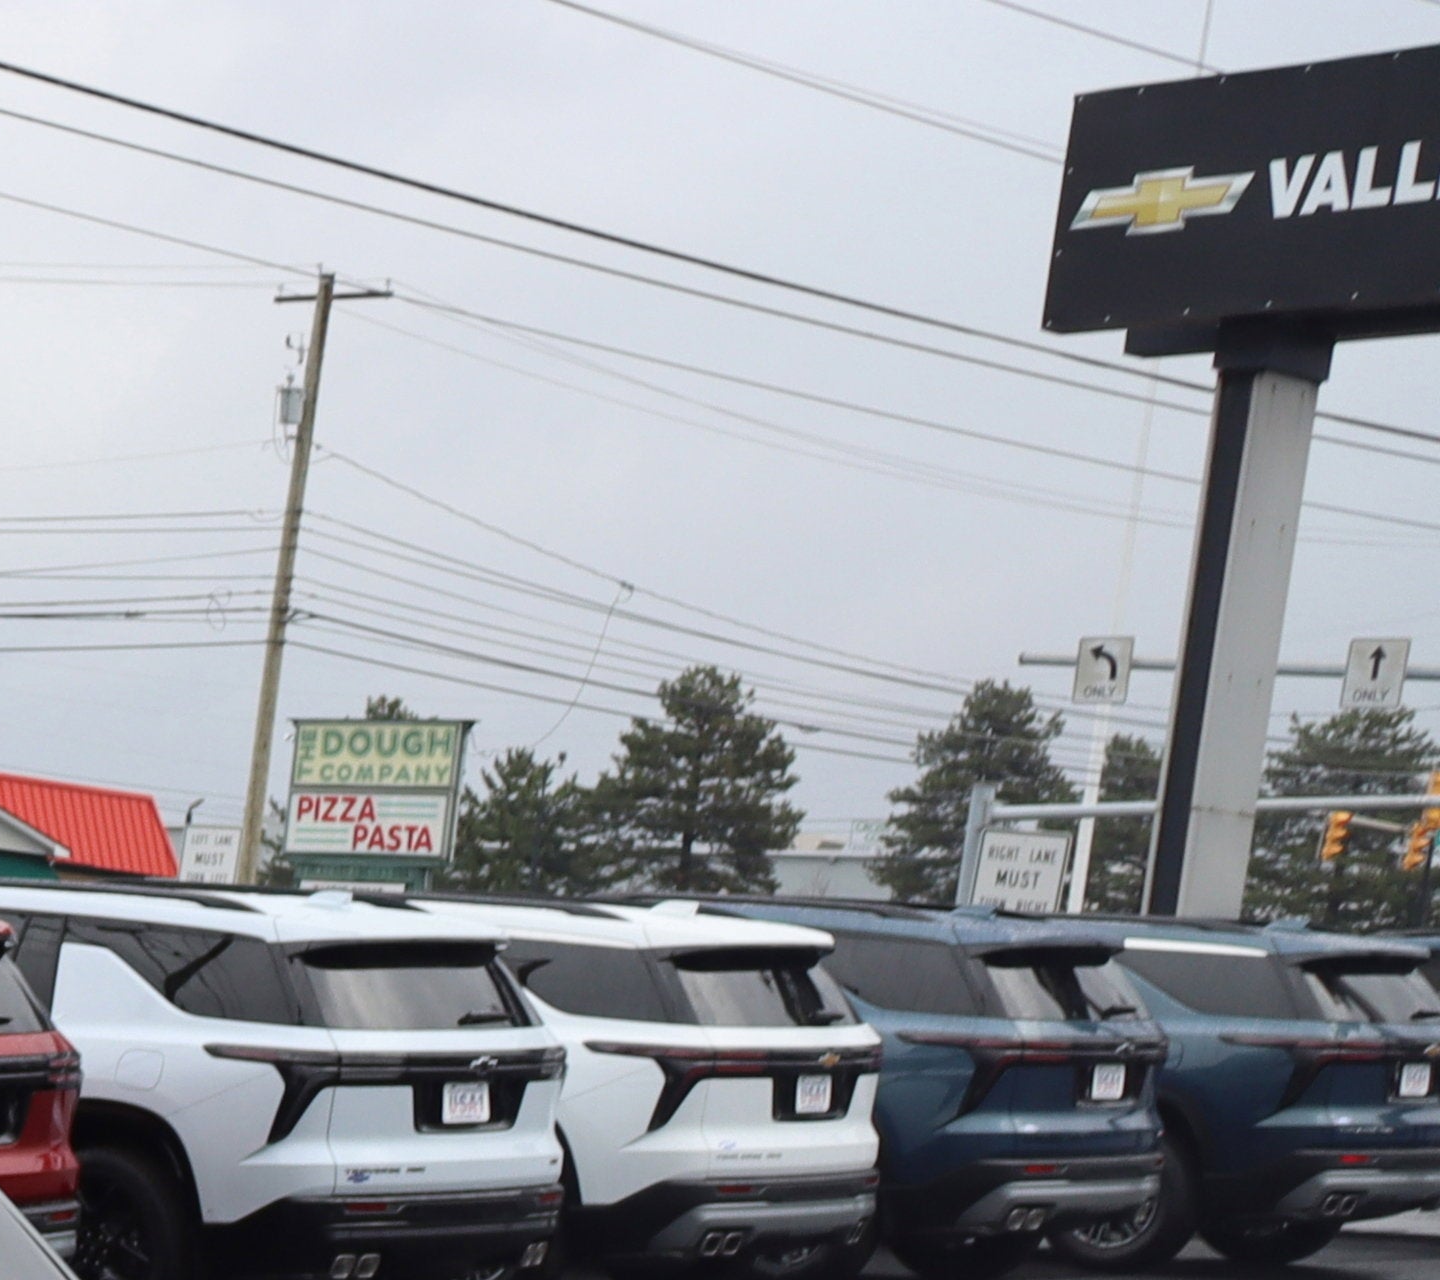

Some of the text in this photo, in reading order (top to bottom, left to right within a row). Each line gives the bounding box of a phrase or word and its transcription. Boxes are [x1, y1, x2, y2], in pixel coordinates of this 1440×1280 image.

[1269, 139, 1440, 219] VALL
[1083, 685, 1117, 699] ONLY
[1352, 687, 1393, 702] ONLY
[323, 728, 451, 759] DOUGH
[297, 729, 318, 780] THE
[319, 765, 449, 783] COMPANY
[297, 796, 375, 823] PIZZA
[352, 825, 433, 852] PASTA
[194, 851, 225, 867] MUST
[987, 844, 1057, 865] RIGHT LANE
[994, 869, 1041, 890] MUST
